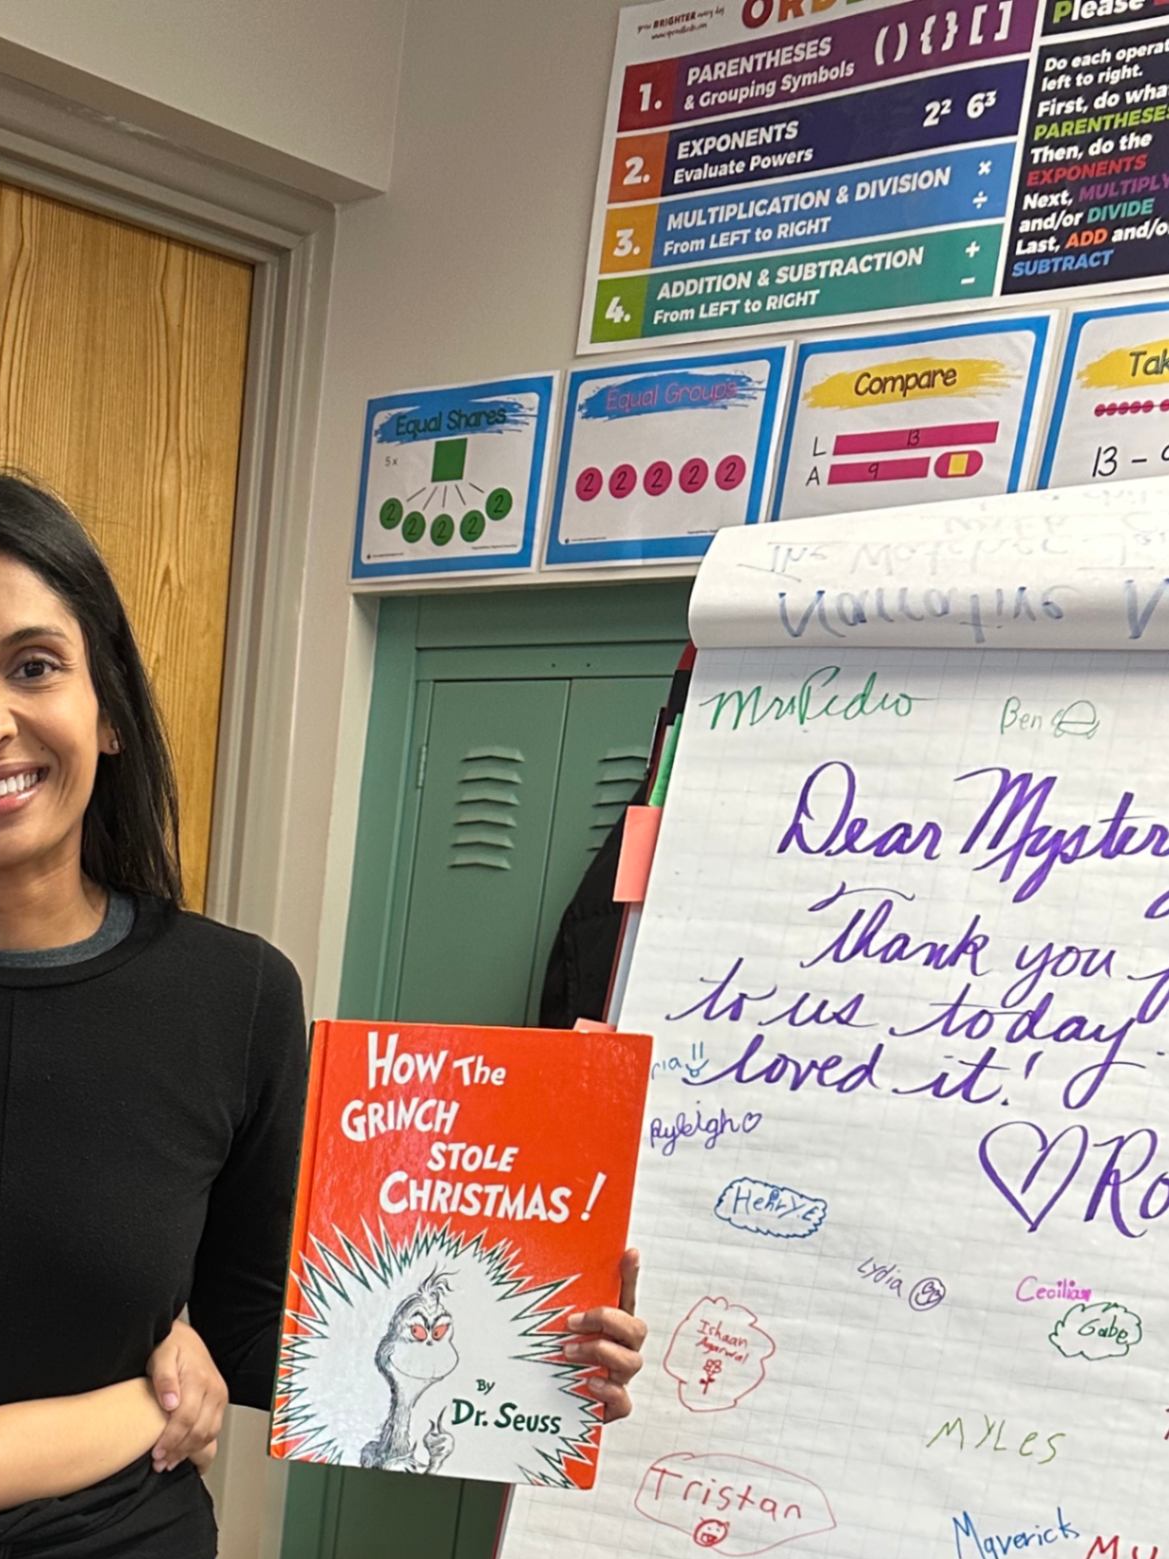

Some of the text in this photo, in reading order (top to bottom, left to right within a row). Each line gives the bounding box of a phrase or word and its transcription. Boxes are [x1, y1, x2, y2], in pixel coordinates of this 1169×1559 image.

[687, 36, 832, 86] PARENTHESES
[1044, 56, 1068, 73] Do
[1071, 46, 1111, 68] each
[684, 60, 855, 110] & Grouping Symbols
[1041, 64, 1143, 92] left to right.
[639, 83, 662, 112] 1.
[1036, 96, 1089, 118] First,
[1093, 91, 1120, 110] do
[677, 120, 799, 161] EXPONENTS
[1030, 132, 1153, 165] Then, do the
[623, 156, 650, 185] 2.
[673, 146, 814, 185] Evaluate Powers
[1026, 153, 1149, 187] EXPONENTS
[666, 166, 952, 232] MULTIPLICATION & DIVISION
[1022, 191, 1073, 211] Next,
[1018, 197, 1155, 234] and/or DIVIDE
[613, 228, 640, 257] 3.
[663, 217, 831, 256] From LEFT to RIGHT
[1015, 238, 1060, 257] Last,
[1064, 228, 1108, 250] ADD
[657, 246, 924, 300] ADDITION & SUBTRACTION
[1011, 249, 1114, 278] SUBTRACT
[605, 296, 631, 323] 4.
[653, 289, 820, 325] From LEFT to RIGHT
[606, 379, 739, 413] Equal Groups
[854, 368, 958, 398] Compare
[395, 406, 508, 440] Equal Shares
[813, 437, 826, 457] L
[1092, 446, 1118, 478] 13
[583, 461, 737, 492] 2 2 2 2 2
[805, 463, 880, 486] A 9
[386, 502, 396, 522] 2
[493, 493, 504, 514] 2
[408, 518, 417, 536] 2
[437, 520, 447, 540] 2
[468, 516, 477, 536] 2
[1001, 696, 1042, 734] Ben
[777, 761, 942, 860] Dear
[799, 881, 991, 977] Thank
[1000, 941, 1116, 1009] you
[665, 957, 777, 1022] to
[758, 991, 879, 1028] us
[888, 983, 1146, 1109] today
[453, 1054, 507, 1088] The
[681, 1034, 884, 1093] loved
[341, 1097, 460, 1142] GRINCH
[427, 1142, 520, 1173] STOLE
[1078, 1316, 1130, 1346] Gabe
[476, 1378, 495, 1395] By
[451, 1398, 489, 1428] Dr.
[650, 1466, 802, 1523] Tristan
